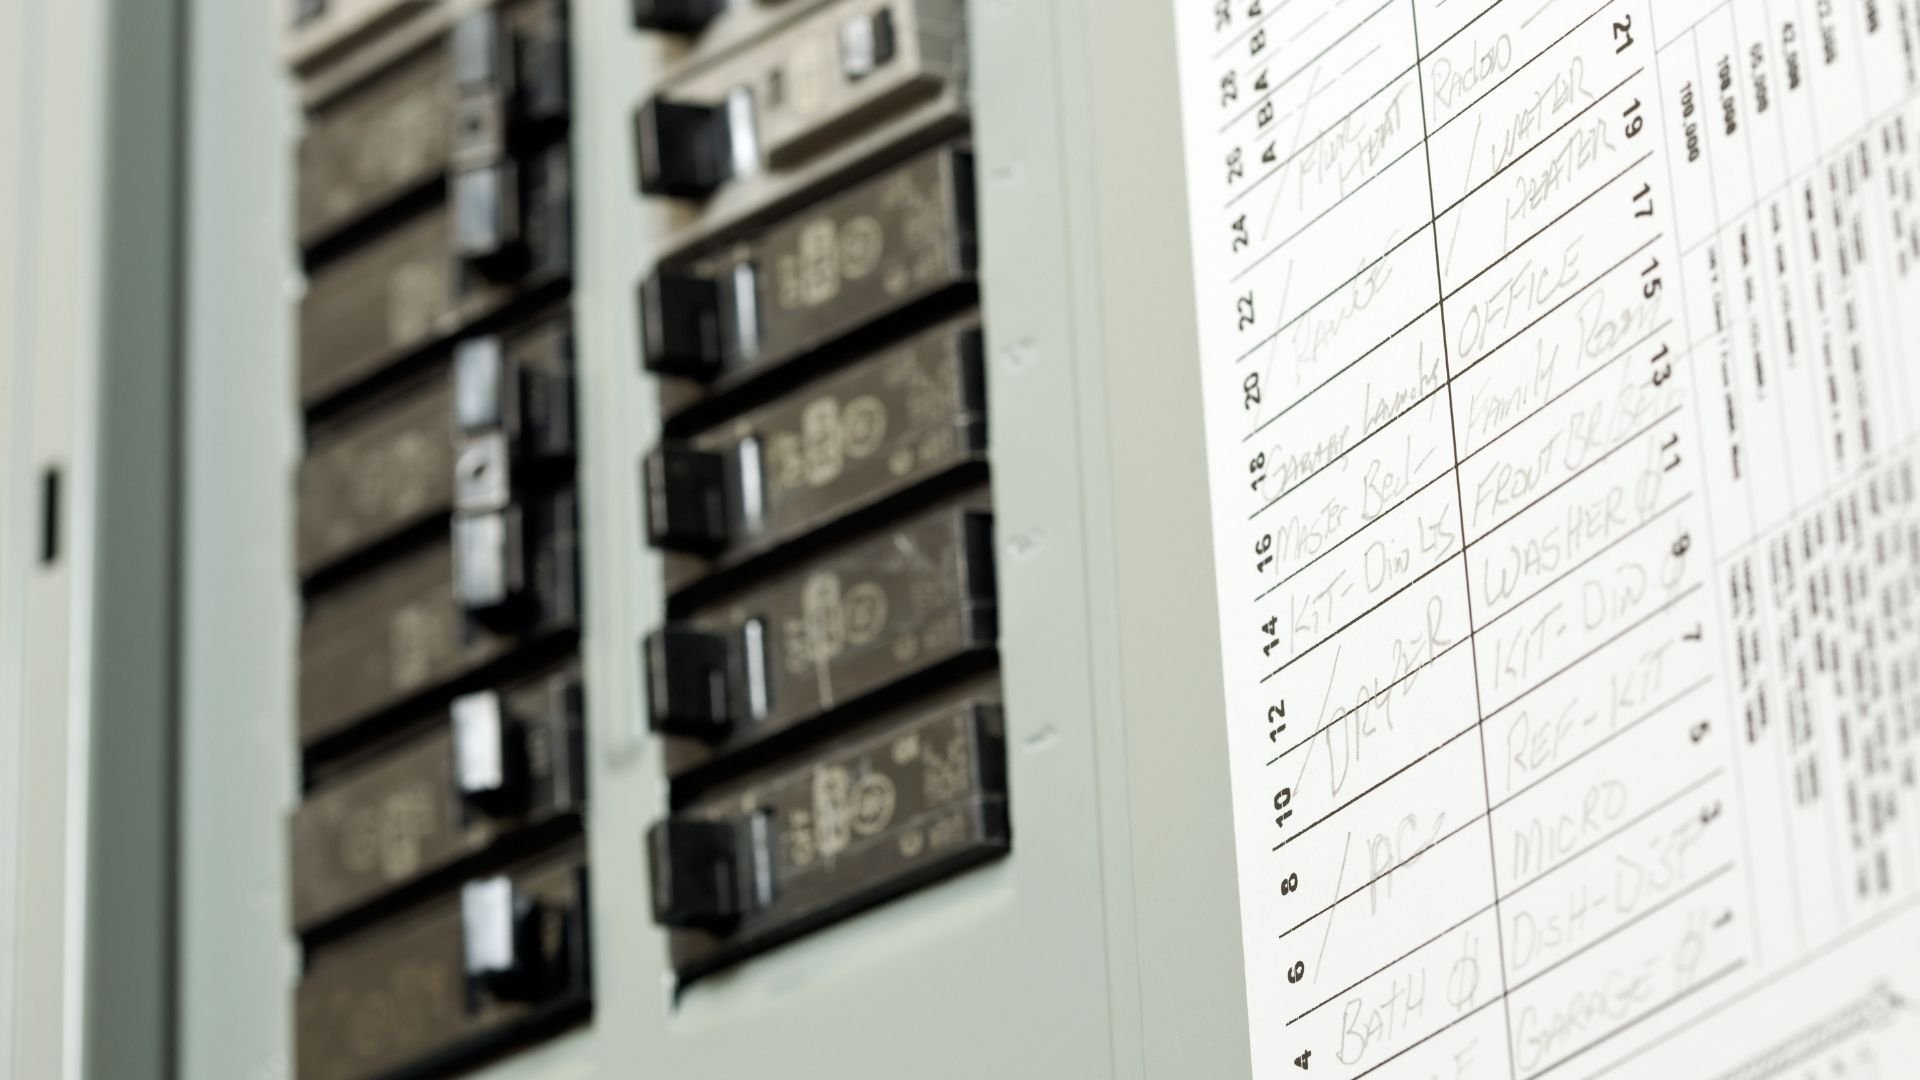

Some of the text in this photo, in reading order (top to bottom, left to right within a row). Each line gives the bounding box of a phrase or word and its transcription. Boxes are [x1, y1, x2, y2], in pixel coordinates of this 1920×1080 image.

[1612, 14, 1634, 55] 21
[1622, 98, 1643, 139] 19
[1632, 182, 1654, 218] 17
[1232, 214, 1248, 252] 24
[1458, 234, 1584, 358] OFFICE
[1641, 257, 1662, 299] 15
[1238, 290, 1254, 331] 22
[1650, 344, 1671, 387] 13
[1244, 372, 1261, 410] 20
[1250, 452, 1266, 491] 18
[1661, 432, 1682, 472] 11
[1255, 533, 1273, 573] 16
[1261, 616, 1280, 656] 14
[1682, 621, 1703, 642] 7
[1268, 699, 1287, 743] 12
[1274, 787, 1293, 828] 10
[1281, 872, 1298, 896] 8
[1287, 960, 1305, 984] 6
[1294, 1049, 1312, 1070] 4
